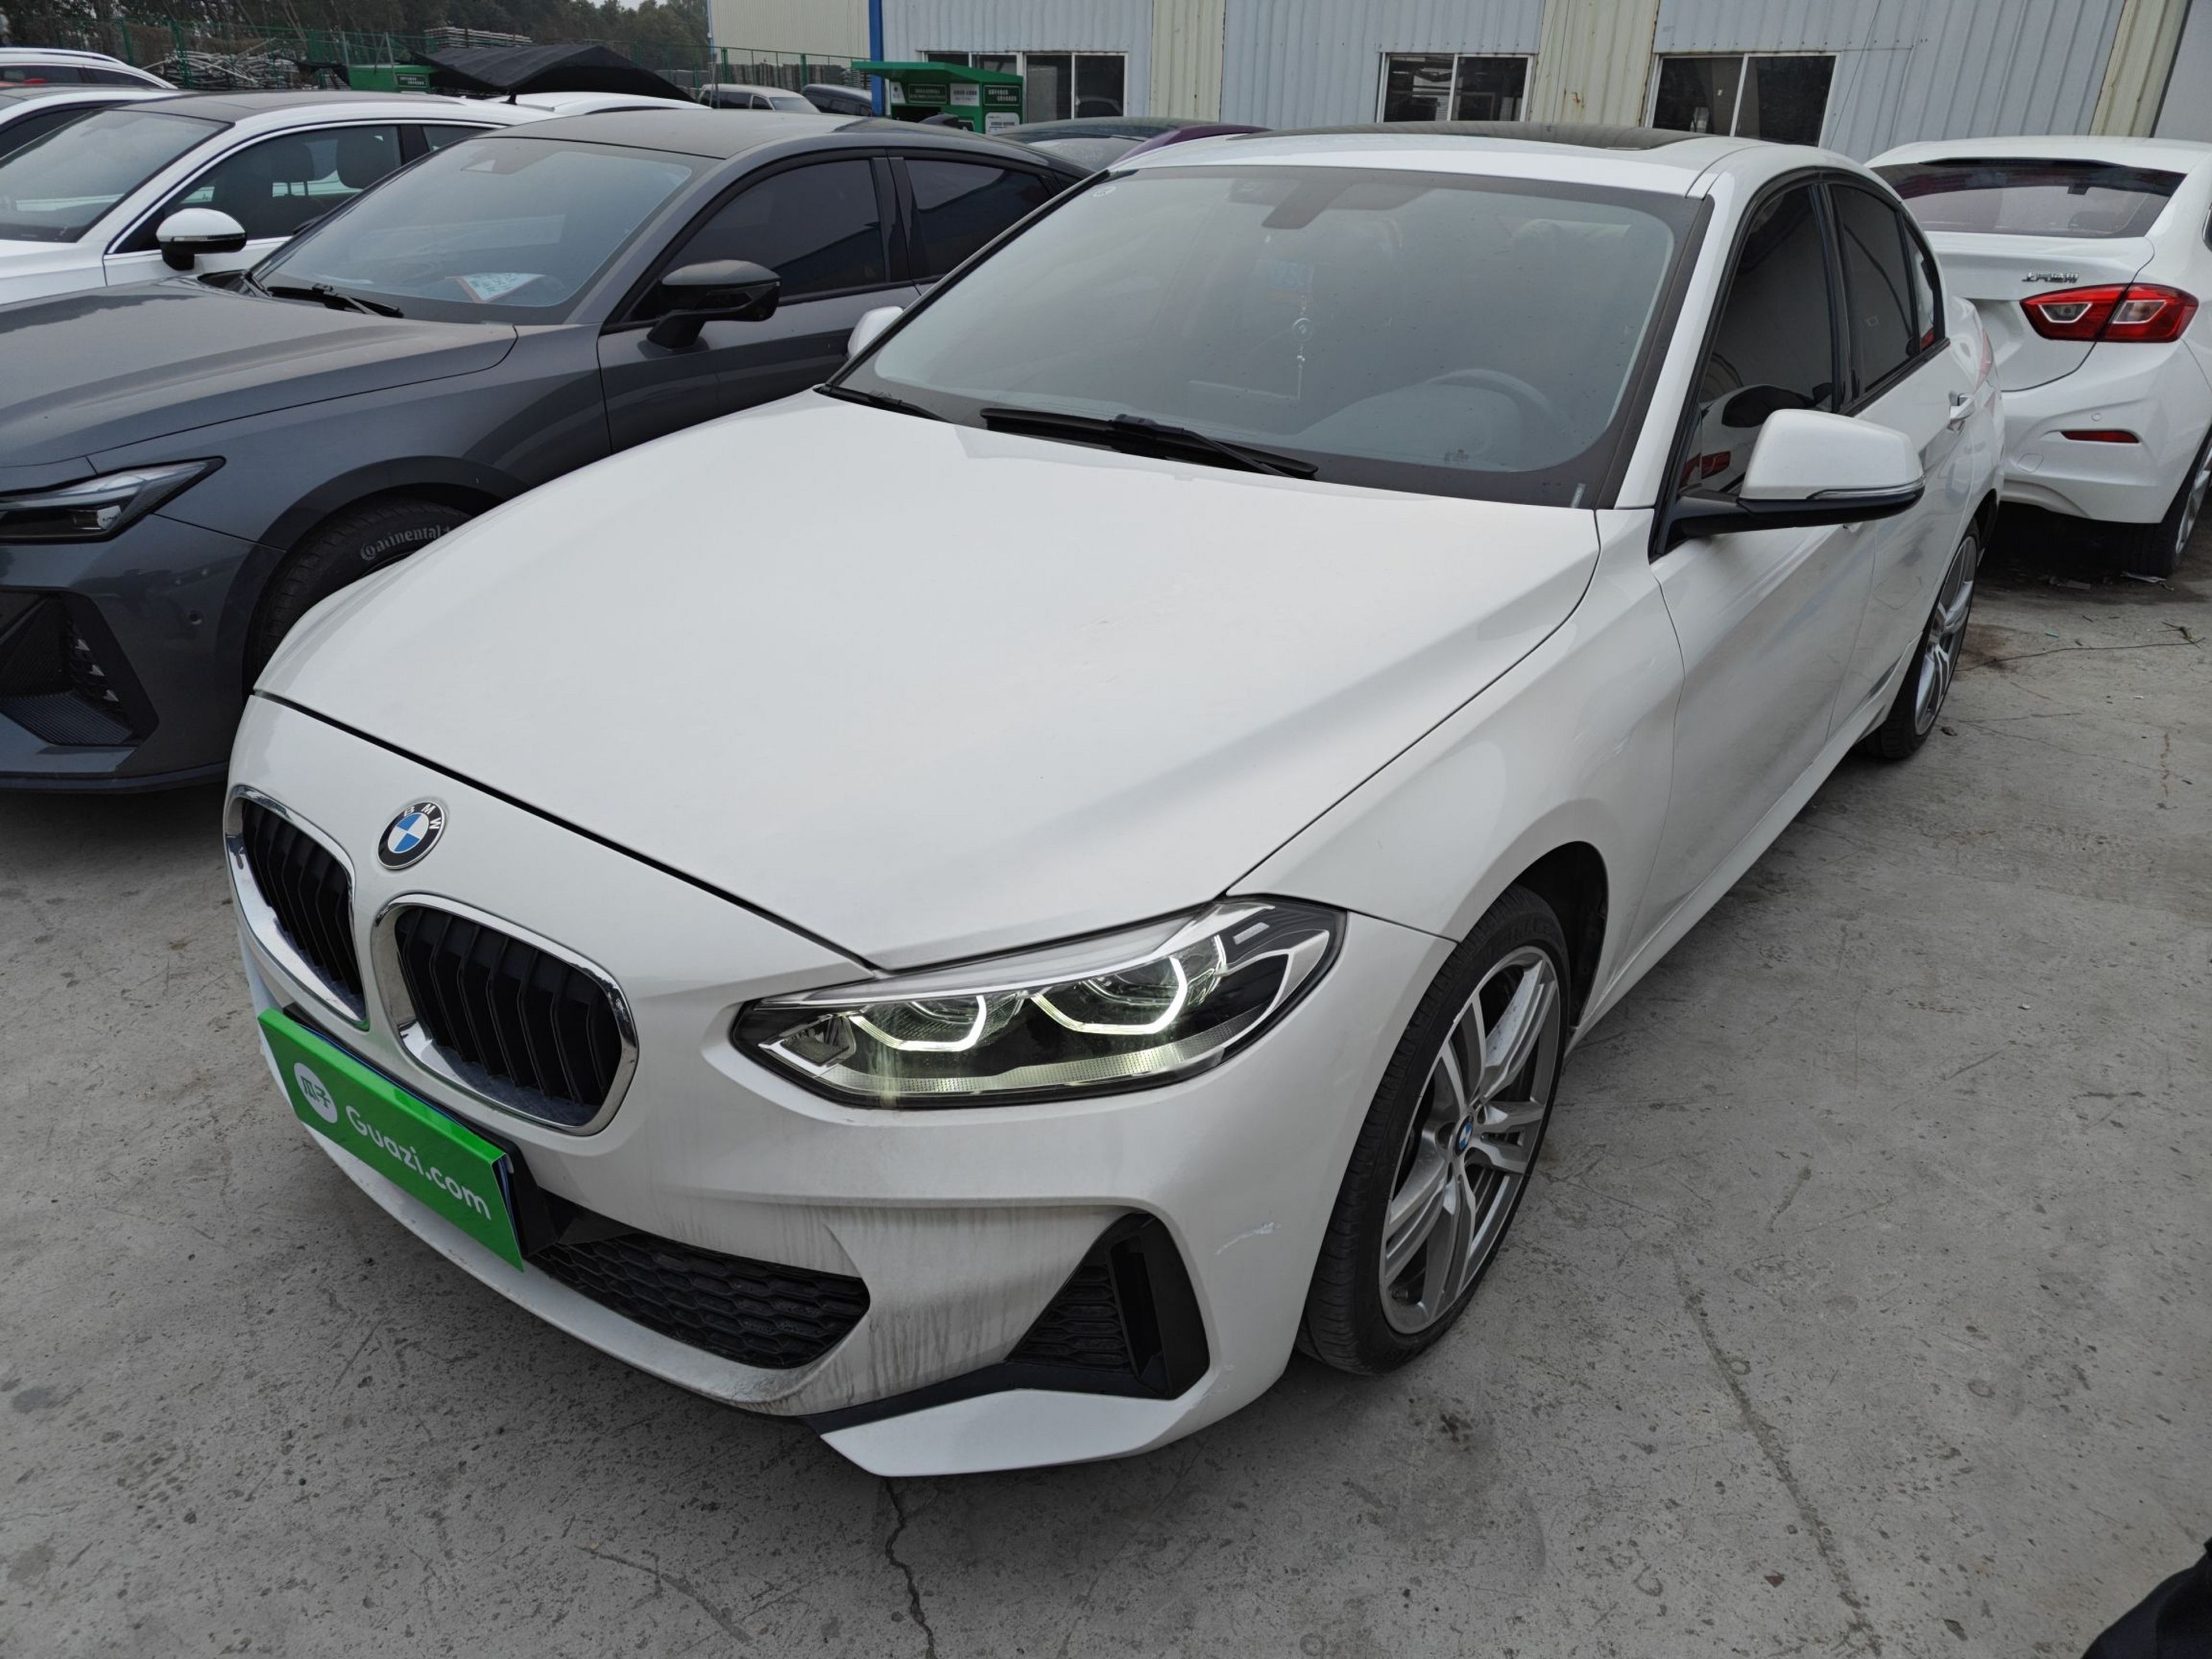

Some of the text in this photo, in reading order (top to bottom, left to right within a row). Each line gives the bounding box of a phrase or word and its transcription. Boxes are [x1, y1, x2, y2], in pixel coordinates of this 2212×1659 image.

[403, 803, 442, 830] BMW
[300, 1075, 330, 1108] 瓜子
[346, 1105, 491, 1221] Guazi.com
